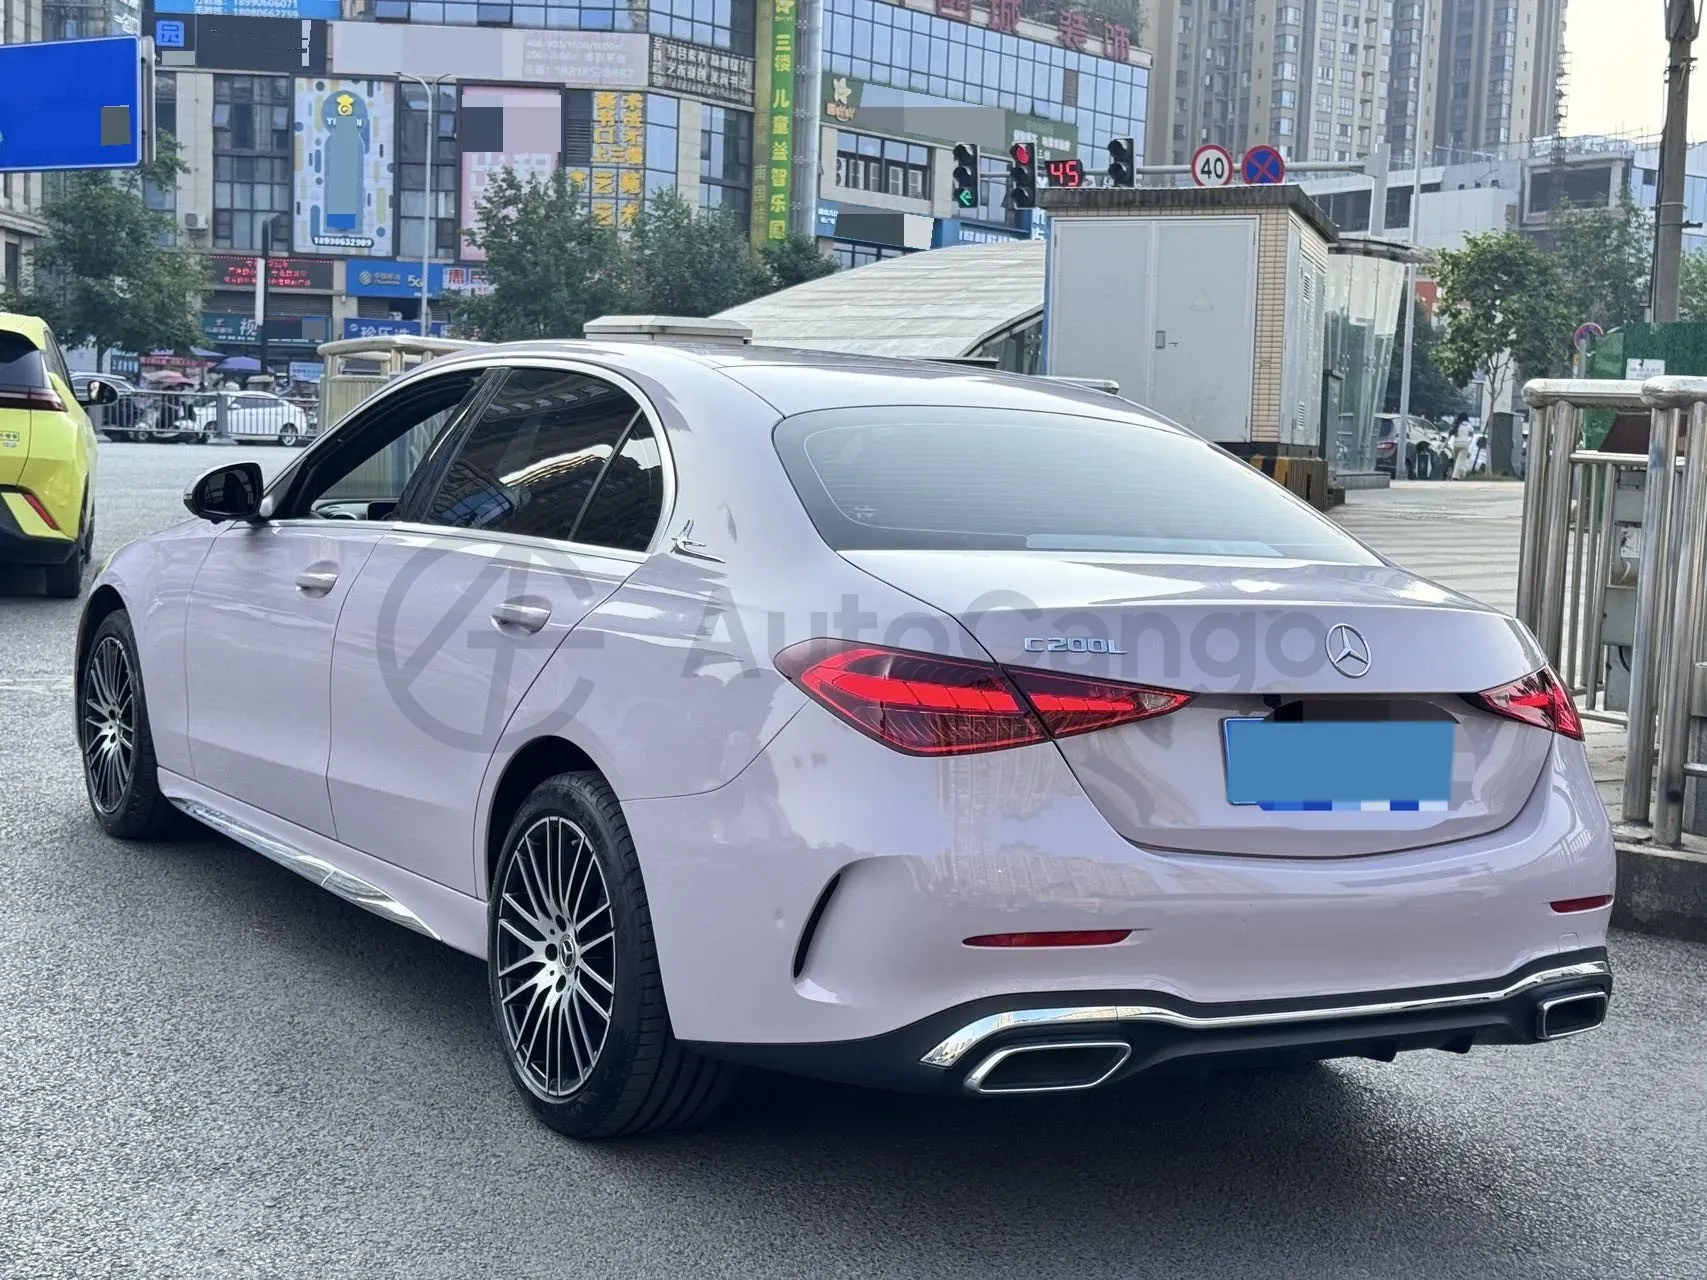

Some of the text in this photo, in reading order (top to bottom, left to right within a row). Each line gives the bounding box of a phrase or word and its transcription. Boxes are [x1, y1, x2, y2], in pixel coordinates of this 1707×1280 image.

[774, 34, 792, 72] 三楼
[768, 88, 790, 240] 儿童益智乐园
[1050, 160, 1079, 187] 45
[1200, 157, 1225, 179] 40
